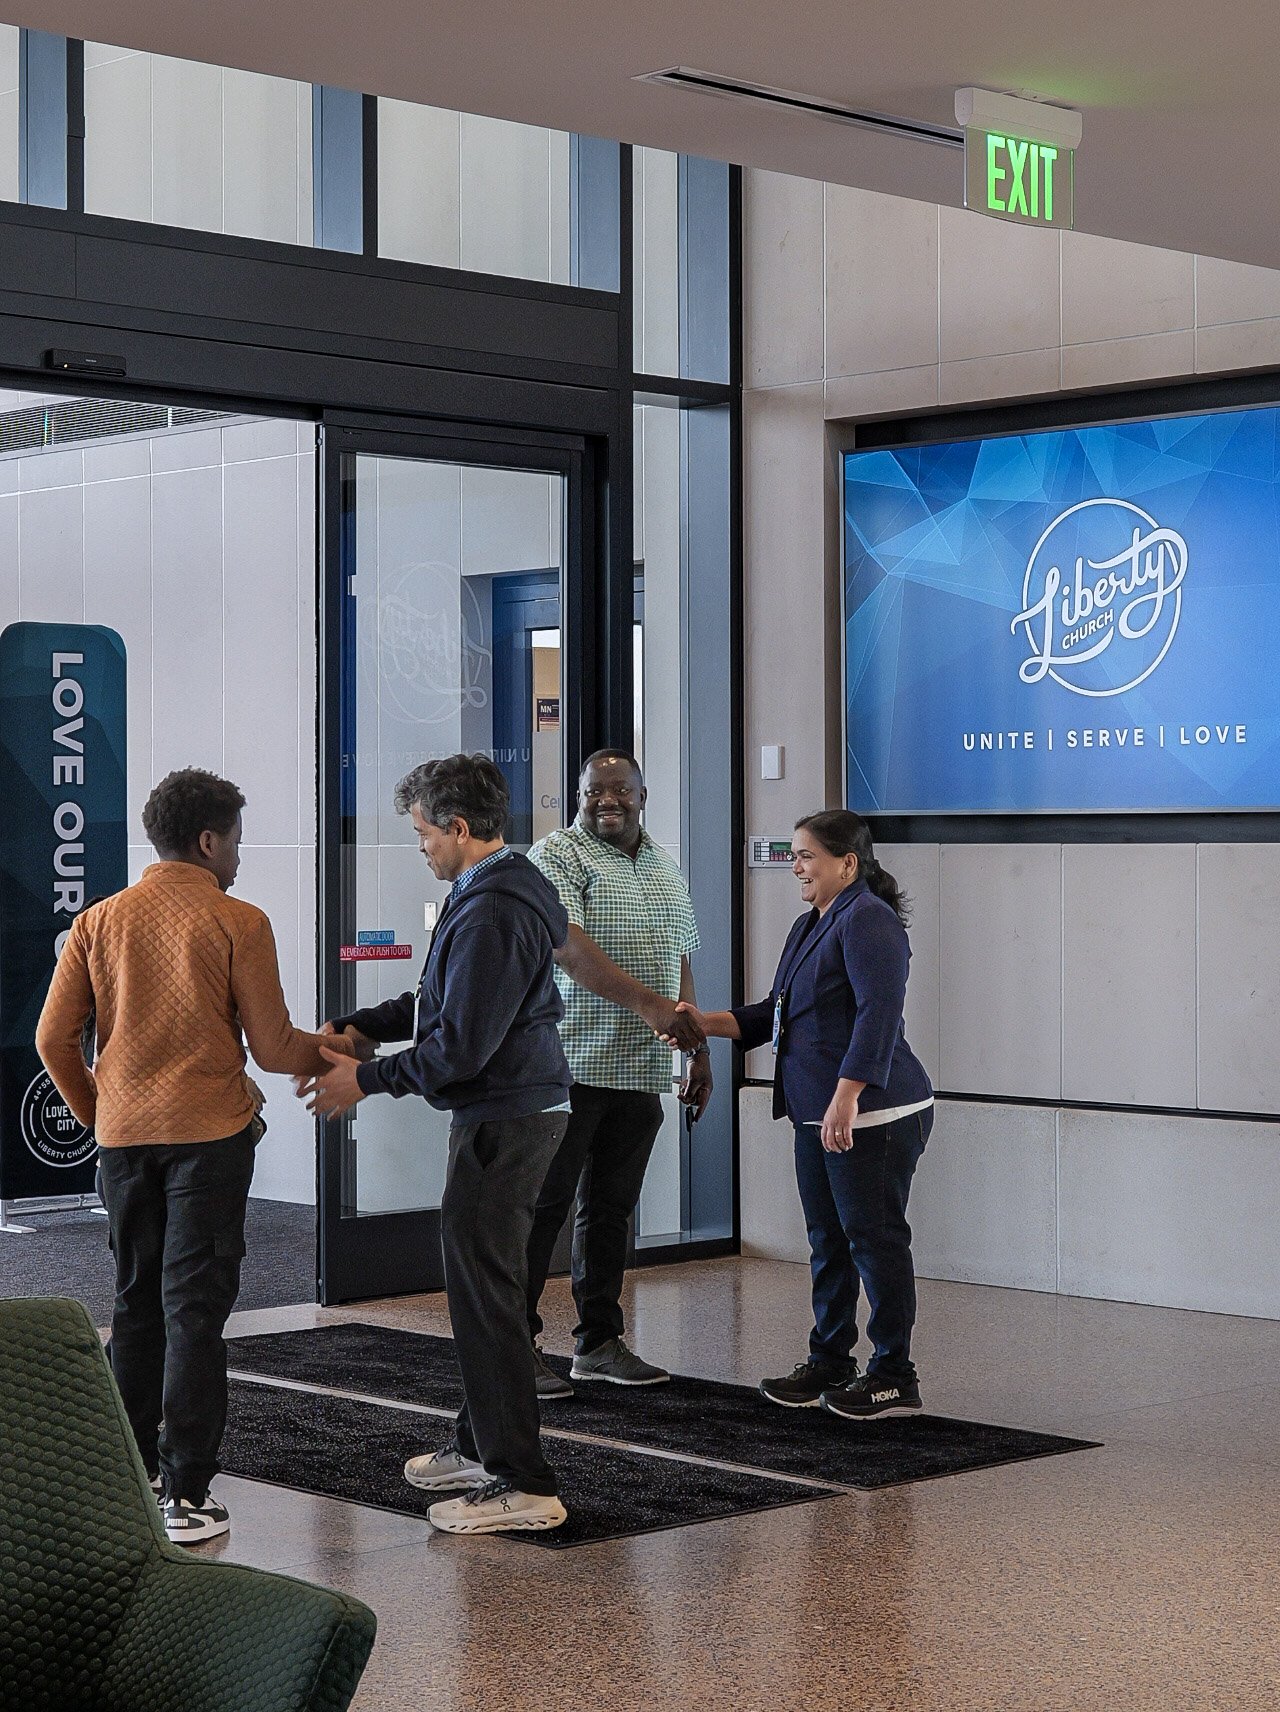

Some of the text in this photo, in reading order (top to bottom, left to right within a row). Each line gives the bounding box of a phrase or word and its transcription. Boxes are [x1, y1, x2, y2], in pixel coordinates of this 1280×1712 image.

[987, 133, 1057, 221] EXIT
[1011, 527, 1189, 684] Liberty
[1062, 608, 1115, 650] CHURCH
[52, 652, 84, 786] LOVE
[963, 731, 1034, 750] UNITE
[1067, 728, 1145, 748] SERVE
[1179, 725, 1247, 745] LOVE
[53, 801, 85, 914] OUR
[347, 947, 376, 957] EMERGENCY
[376, 946, 390, 957] PUSH
[390, 946, 397, 956] TO
[397, 945, 411, 956] OPEN
[46, 1106, 68, 1118] LOVE
[57, 1119, 76, 1131] CITY
[37, 1136, 95, 1159] LIBERTY CHURCH
[871, 1388, 900, 1404] HOKA
